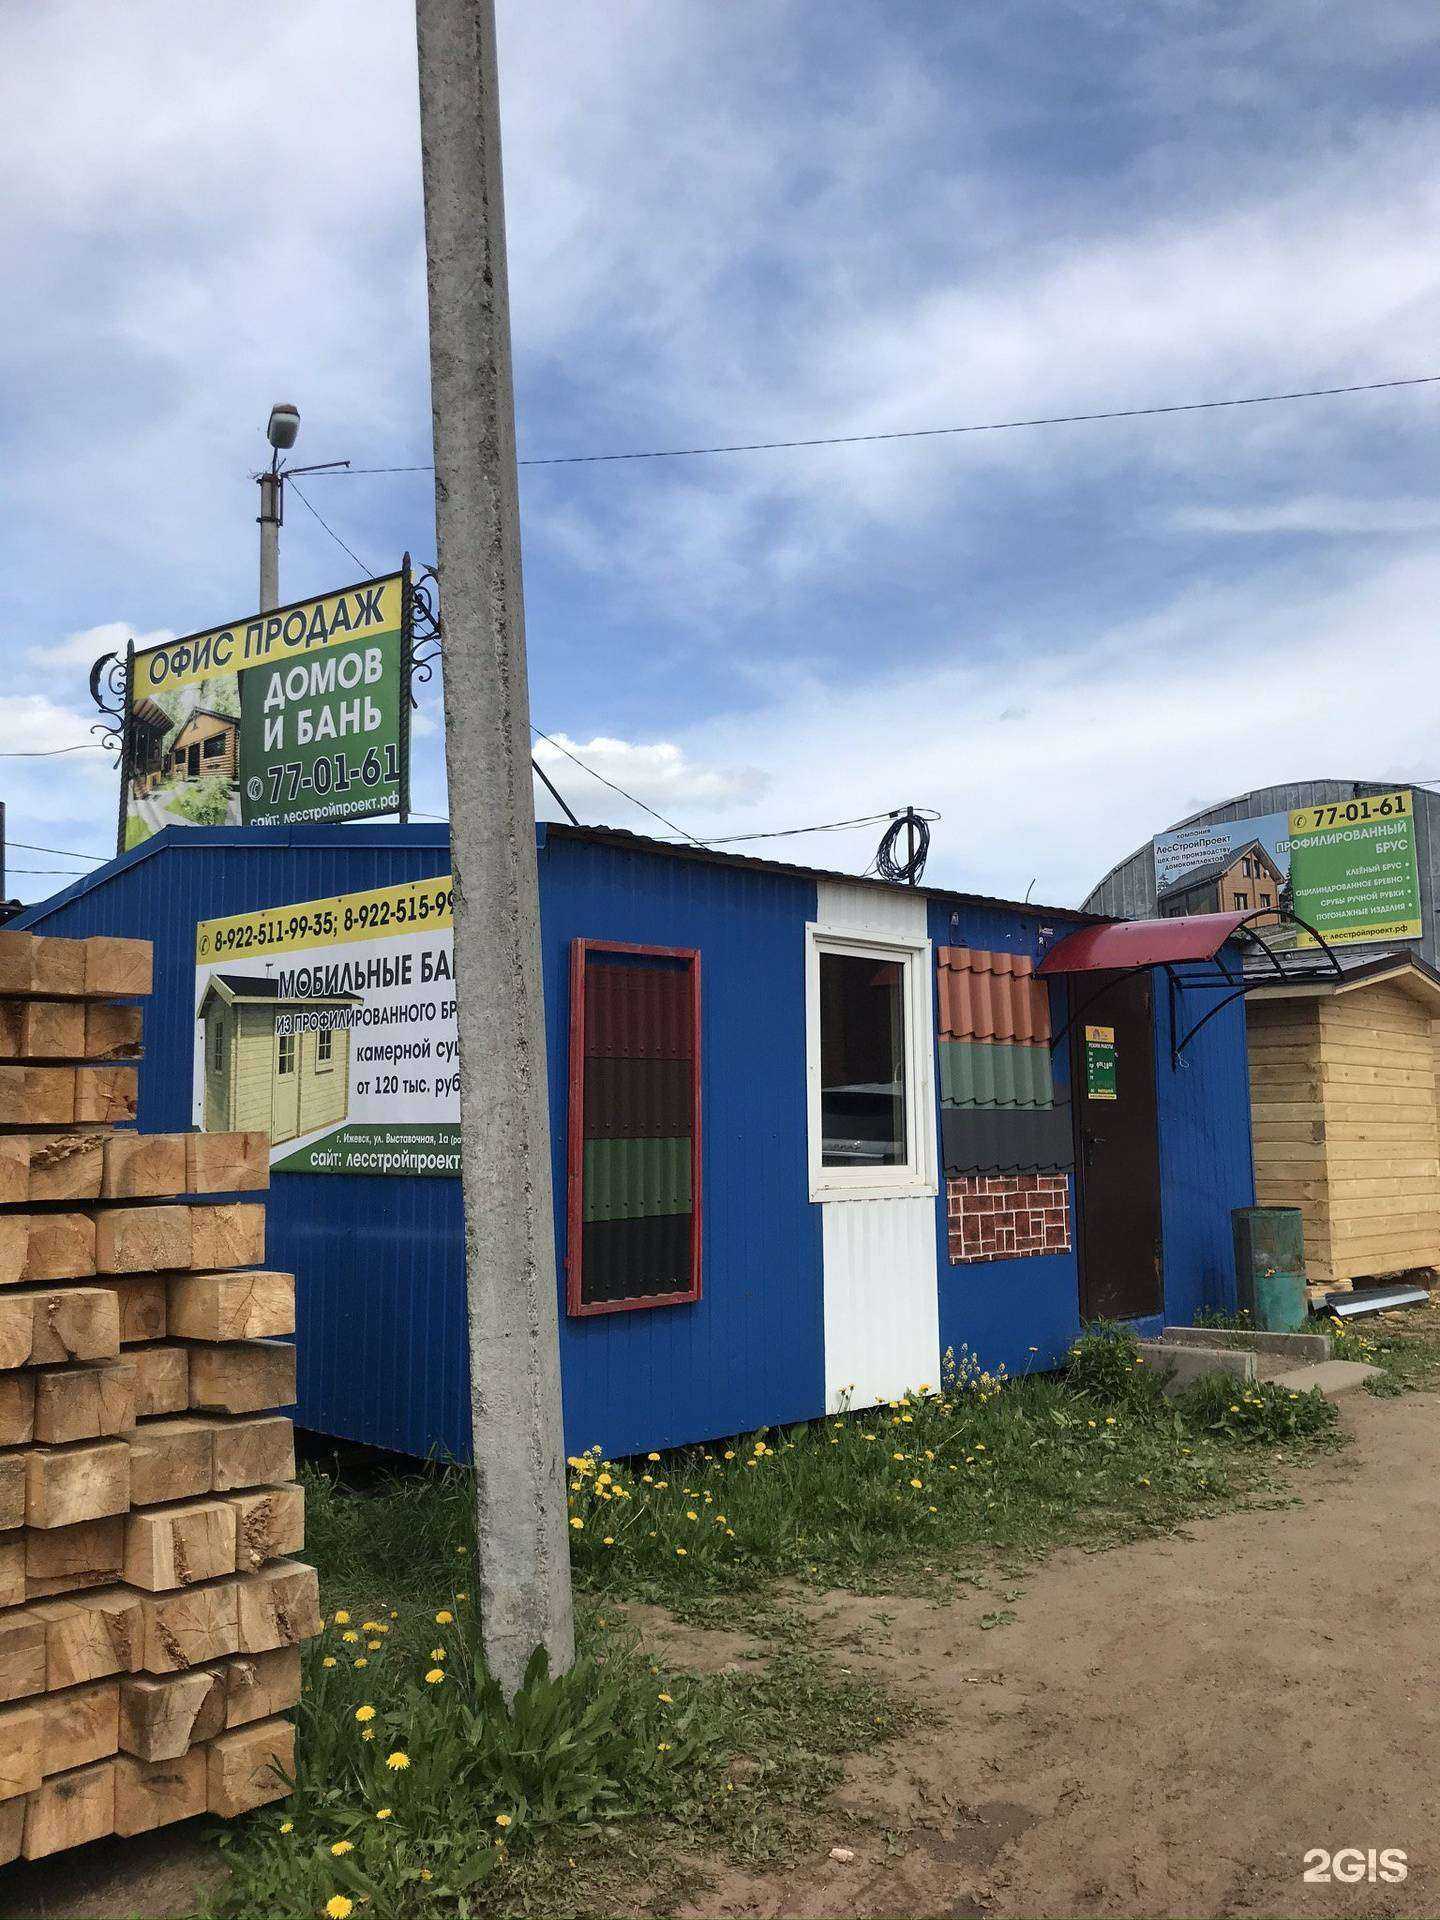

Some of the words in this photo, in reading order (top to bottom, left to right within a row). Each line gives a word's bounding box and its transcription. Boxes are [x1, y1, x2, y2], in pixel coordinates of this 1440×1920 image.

[149, 631, 234, 685] ОФИС
[244, 586, 385, 658] ПРОДАЖ
[264, 648, 383, 714] ДОМОВ
[264, 714, 284, 752] И
[297, 696, 382, 746] БАНЬ
[268, 744, 400, 804] 77-01-61
[283, 791, 399, 824] лесстройпроект.рф
[1313, 796, 1406, 827] 77-01-61
[1276, 820, 1408, 853] ПРОФИЛИРОВАННЫЙ
[1375, 840, 1408, 854] БРУС
[1181, 847, 1231, 860] производству
[1382, 862, 1402, 871] БРУС
[215, 913, 338, 952] 8-922-511-99-35;
[279, 953, 412, 999] МОБИЛЬНЫЕ
[421, 950, 455, 983] БА
[276, 1014, 291, 1035] ИЗ
[294, 1003, 436, 1033] ПРОФИЛИРОВАННОГО
[357, 1038, 430, 1066] камерной
[357, 1081, 370, 1095] от
[375, 1075, 398, 1095] 120
[403, 1079, 430, 1093] тыс.
[336, 1135, 342, 1143] г.
[344, 1133, 372, 1145] Ижевск,
[374, 1134, 384, 1146] ул.
[386, 1133, 437, 1146] Выставочная,
[439, 1133, 449, 1144] 1а
[310, 1149, 342, 1167] сайт:
